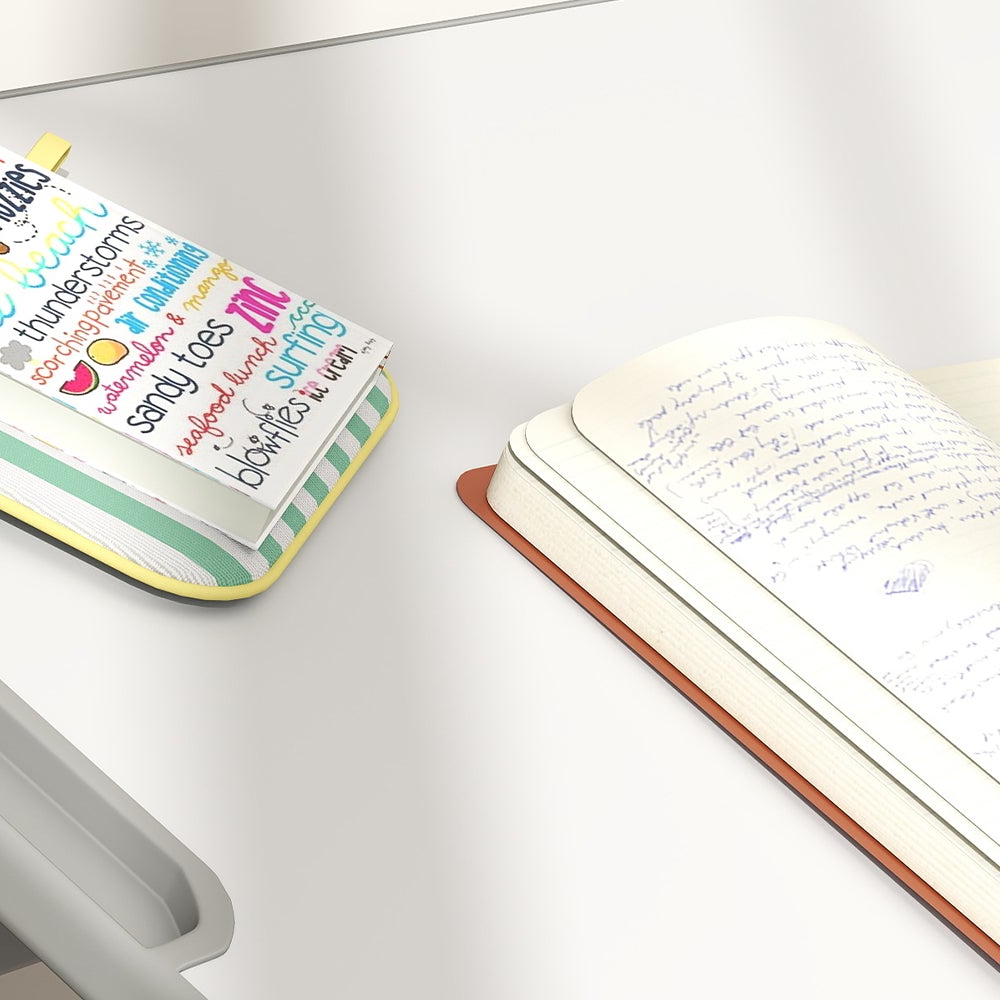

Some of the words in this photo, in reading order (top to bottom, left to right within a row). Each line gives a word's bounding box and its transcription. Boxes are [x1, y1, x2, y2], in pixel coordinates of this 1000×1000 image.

[14, 215, 146, 342] thunderstorms
[115, 311, 150, 334] air
[132, 241, 209, 312] conditioning
[98, 326, 175, 415] watermelon
[166, 312, 186, 326] &
[183, 258, 238, 312] mango
[127, 368, 199, 434] sandy
[171, 317, 234, 368] toes
[265, 310, 347, 389] surfing
[176, 383, 235, 456] seafood
[222, 336, 277, 386] lunch
[214, 397, 311, 490] blowflies
